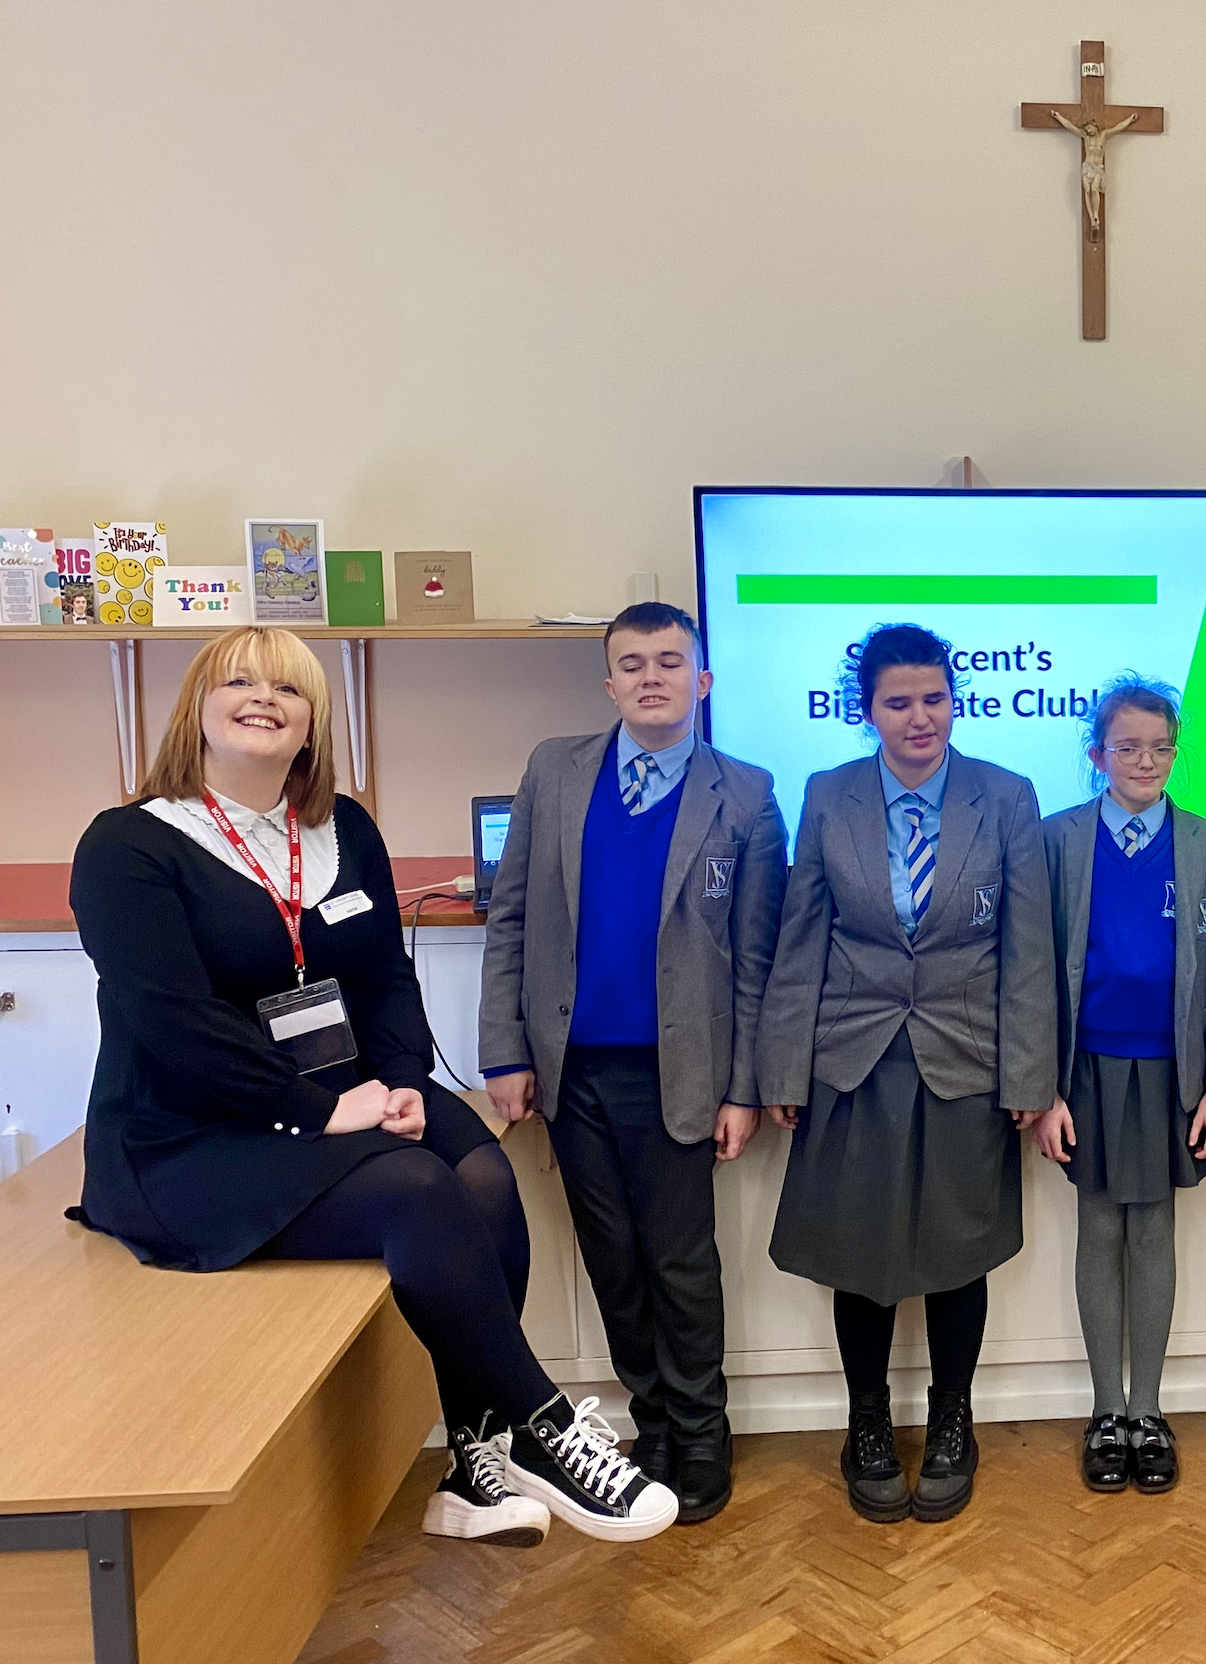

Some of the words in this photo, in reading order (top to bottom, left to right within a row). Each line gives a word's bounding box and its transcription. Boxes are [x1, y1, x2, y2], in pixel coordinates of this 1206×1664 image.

[56, 549, 91, 574] BIG
[165, 579, 242, 593] Thank
[178, 597, 229, 611] You!
[808, 690, 863, 725] Big
[1012, 688, 1098, 718] Club!
[211, 806, 232, 833] VISITOR
[290, 817, 299, 844] VISITOR
[236, 843, 257, 868] VISITOR
[263, 879, 282, 904] VISITOR
